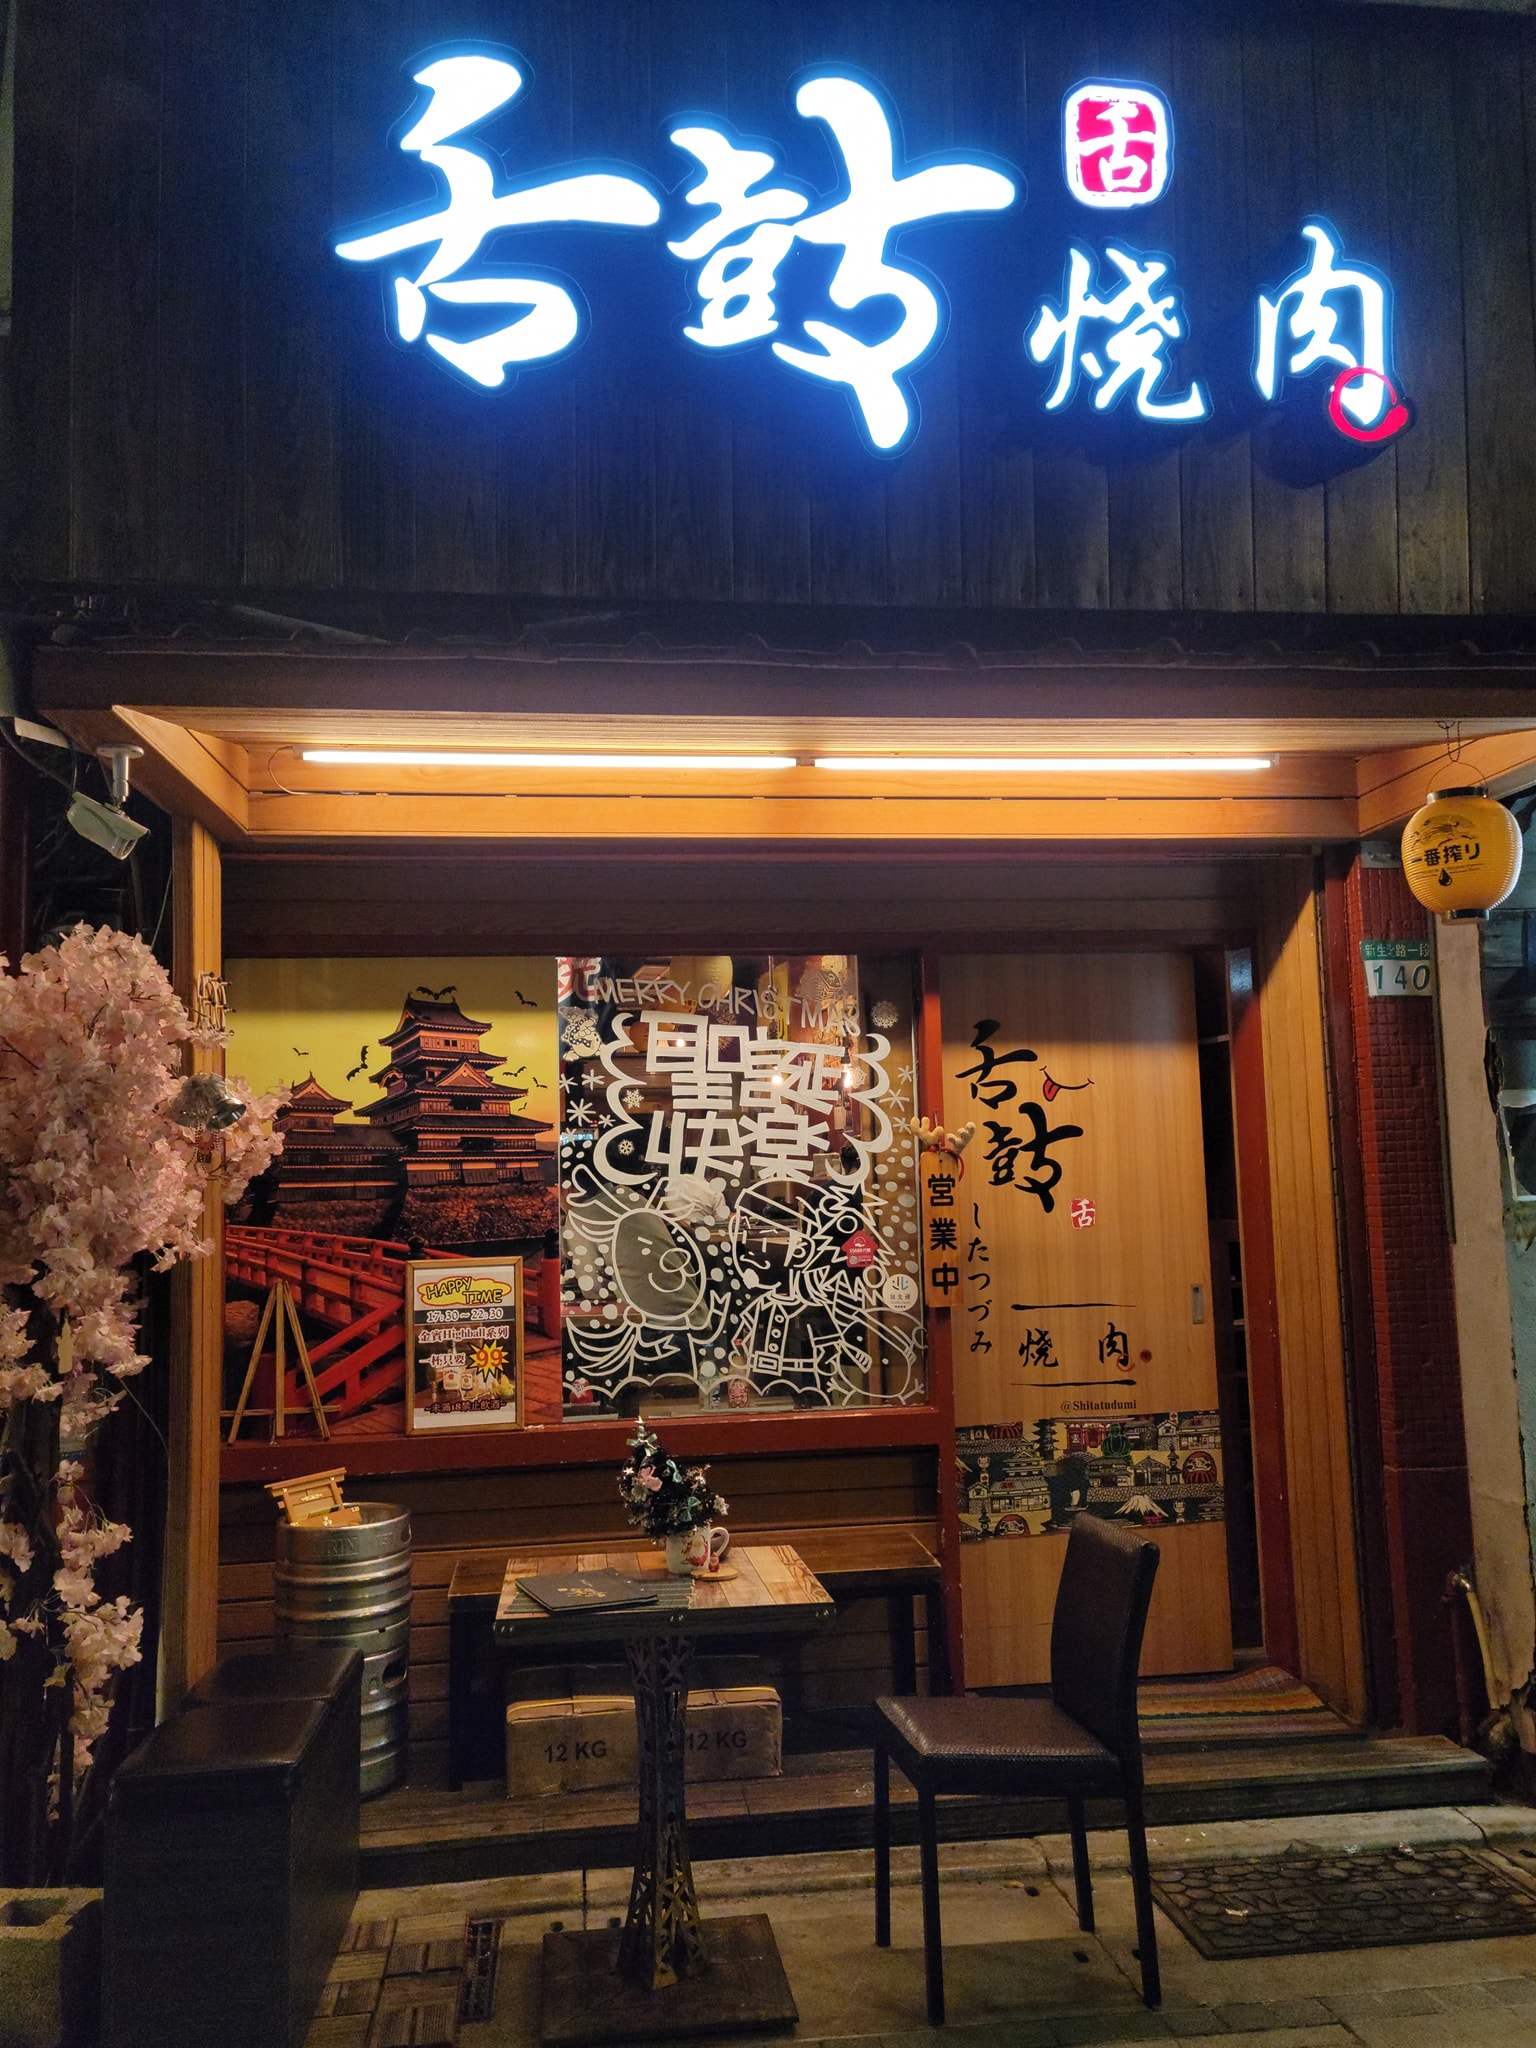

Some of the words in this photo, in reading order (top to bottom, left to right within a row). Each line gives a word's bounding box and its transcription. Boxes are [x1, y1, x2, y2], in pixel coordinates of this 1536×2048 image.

[1411, 843, 1480, 866] 一番搾り
[1373, 964, 1431, 991] 140
[593, 977, 692, 1005] MERRY
[697, 982, 861, 1038] CHRISTMAS
[425, 1276, 472, 1299] HAPPY
[966, 1203, 992, 1354] したつづみ
[462, 1289, 504, 1305] TIME
[476, 1348, 503, 1368] 99
[1060, 1399, 1137, 1413] @Shitatudumi
[544, 1744, 568, 1763] 12
[575, 1740, 607, 1760] KG
[715, 1731, 747, 1749] KG
